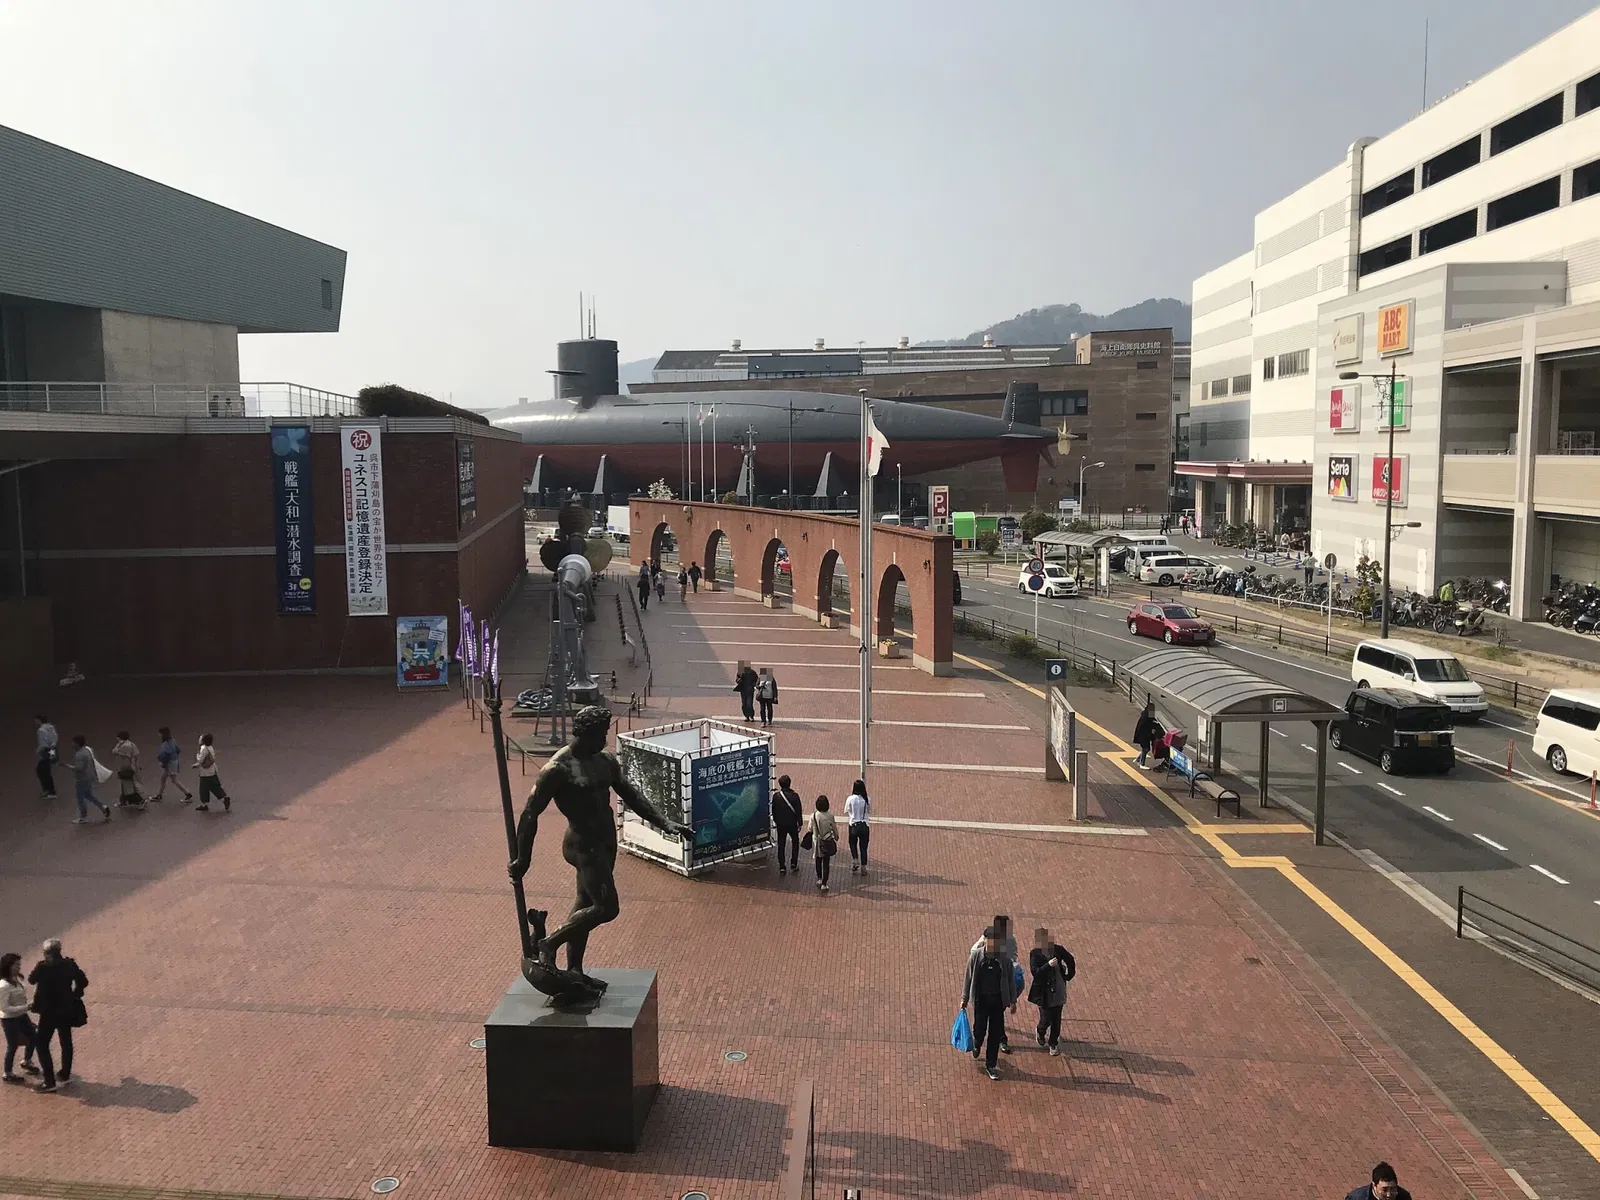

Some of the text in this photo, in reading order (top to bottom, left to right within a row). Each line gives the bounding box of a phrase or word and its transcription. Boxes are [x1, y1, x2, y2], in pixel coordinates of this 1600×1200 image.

[1383, 308, 1402, 332] ABC
[1382, 331, 1401, 348] MART
[353, 432, 369, 449] 祝
[1330, 458, 1350, 476] Seria
[934, 494, 944, 507] P
[284, 461, 302, 577] 戦艦「大和」潜水調査
[354, 454, 373, 594] ユネスコ記憶遺産登録決定
[1032, 561, 1041, 570] 40
[698, 755, 763, 779] 海底の戦艦大和
